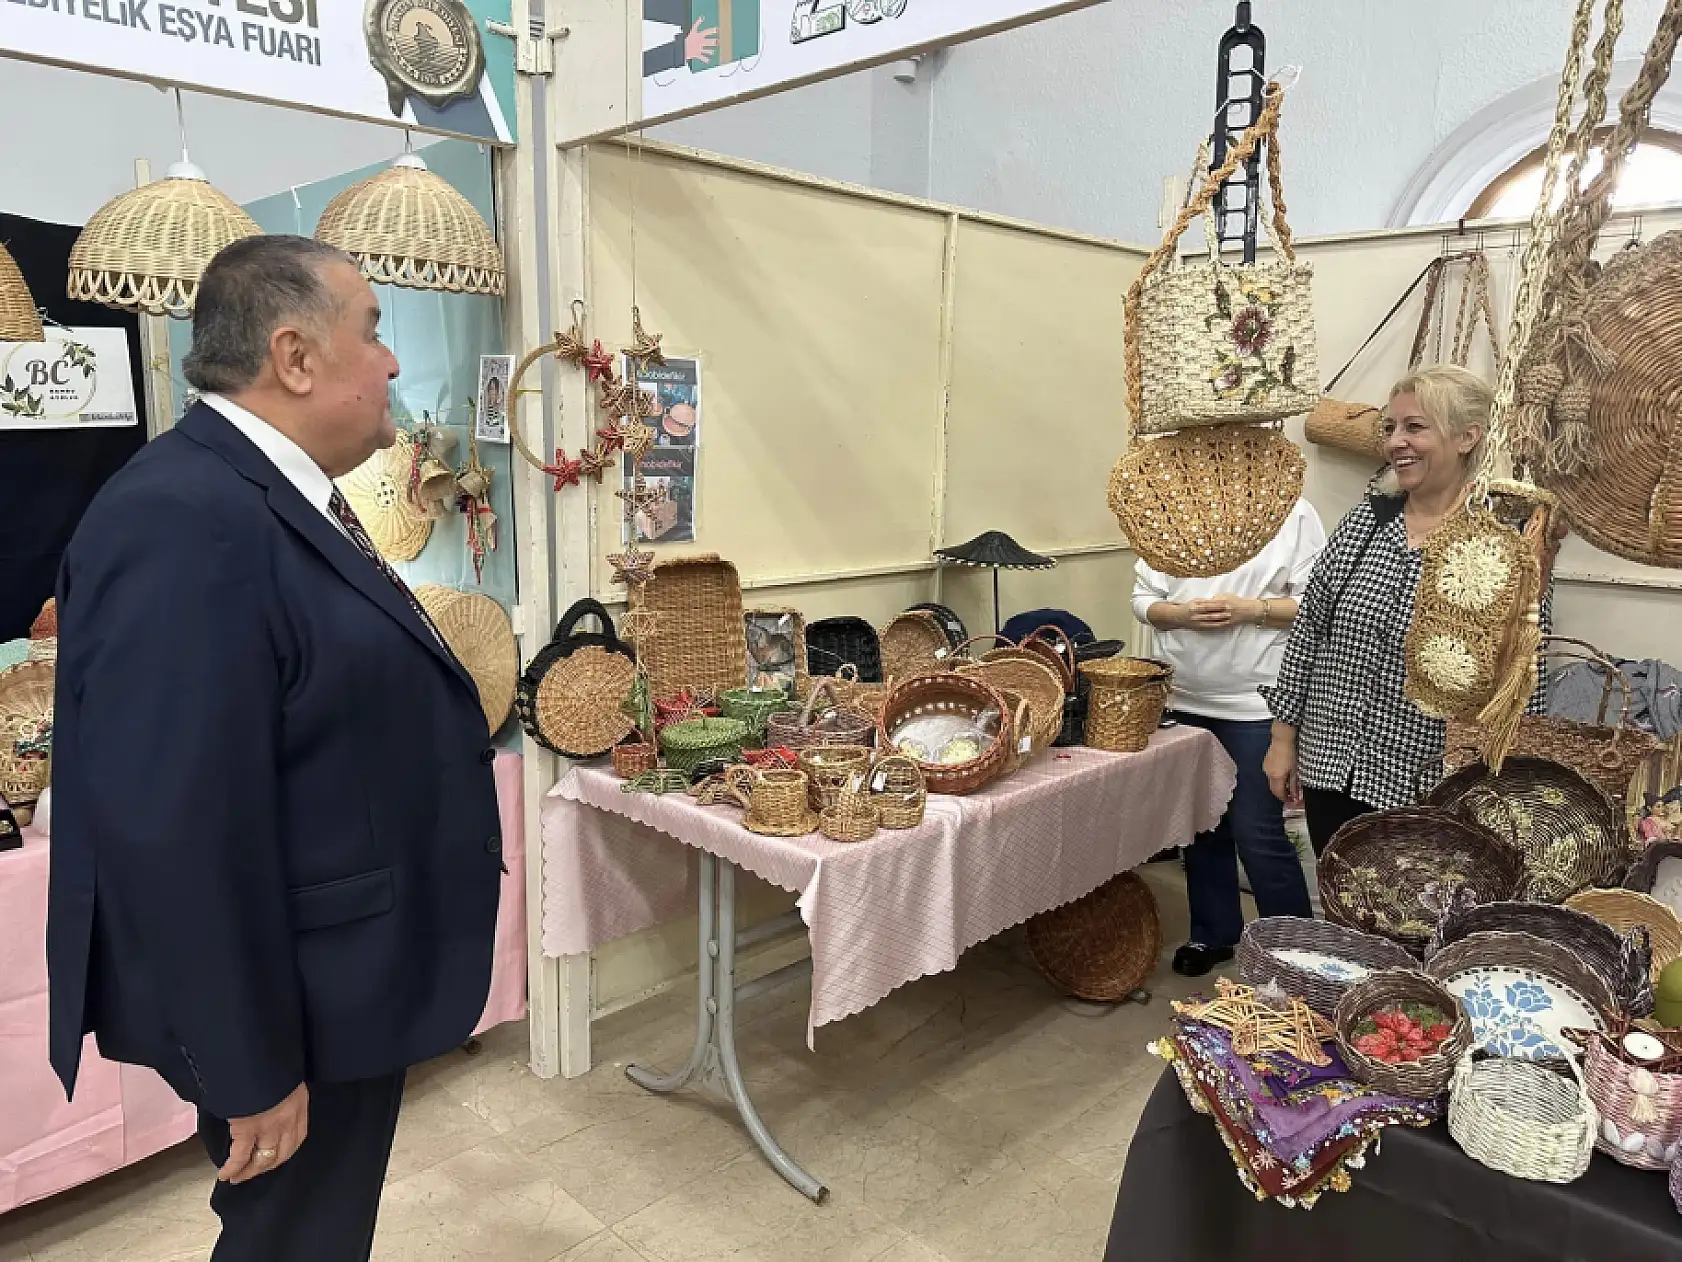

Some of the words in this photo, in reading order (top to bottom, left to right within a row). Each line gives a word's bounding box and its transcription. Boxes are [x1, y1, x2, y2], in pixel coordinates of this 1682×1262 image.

[159, 4, 235, 48] EŞYA
[242, 22, 321, 67] FUARI
[26, 360, 70, 385] BC
